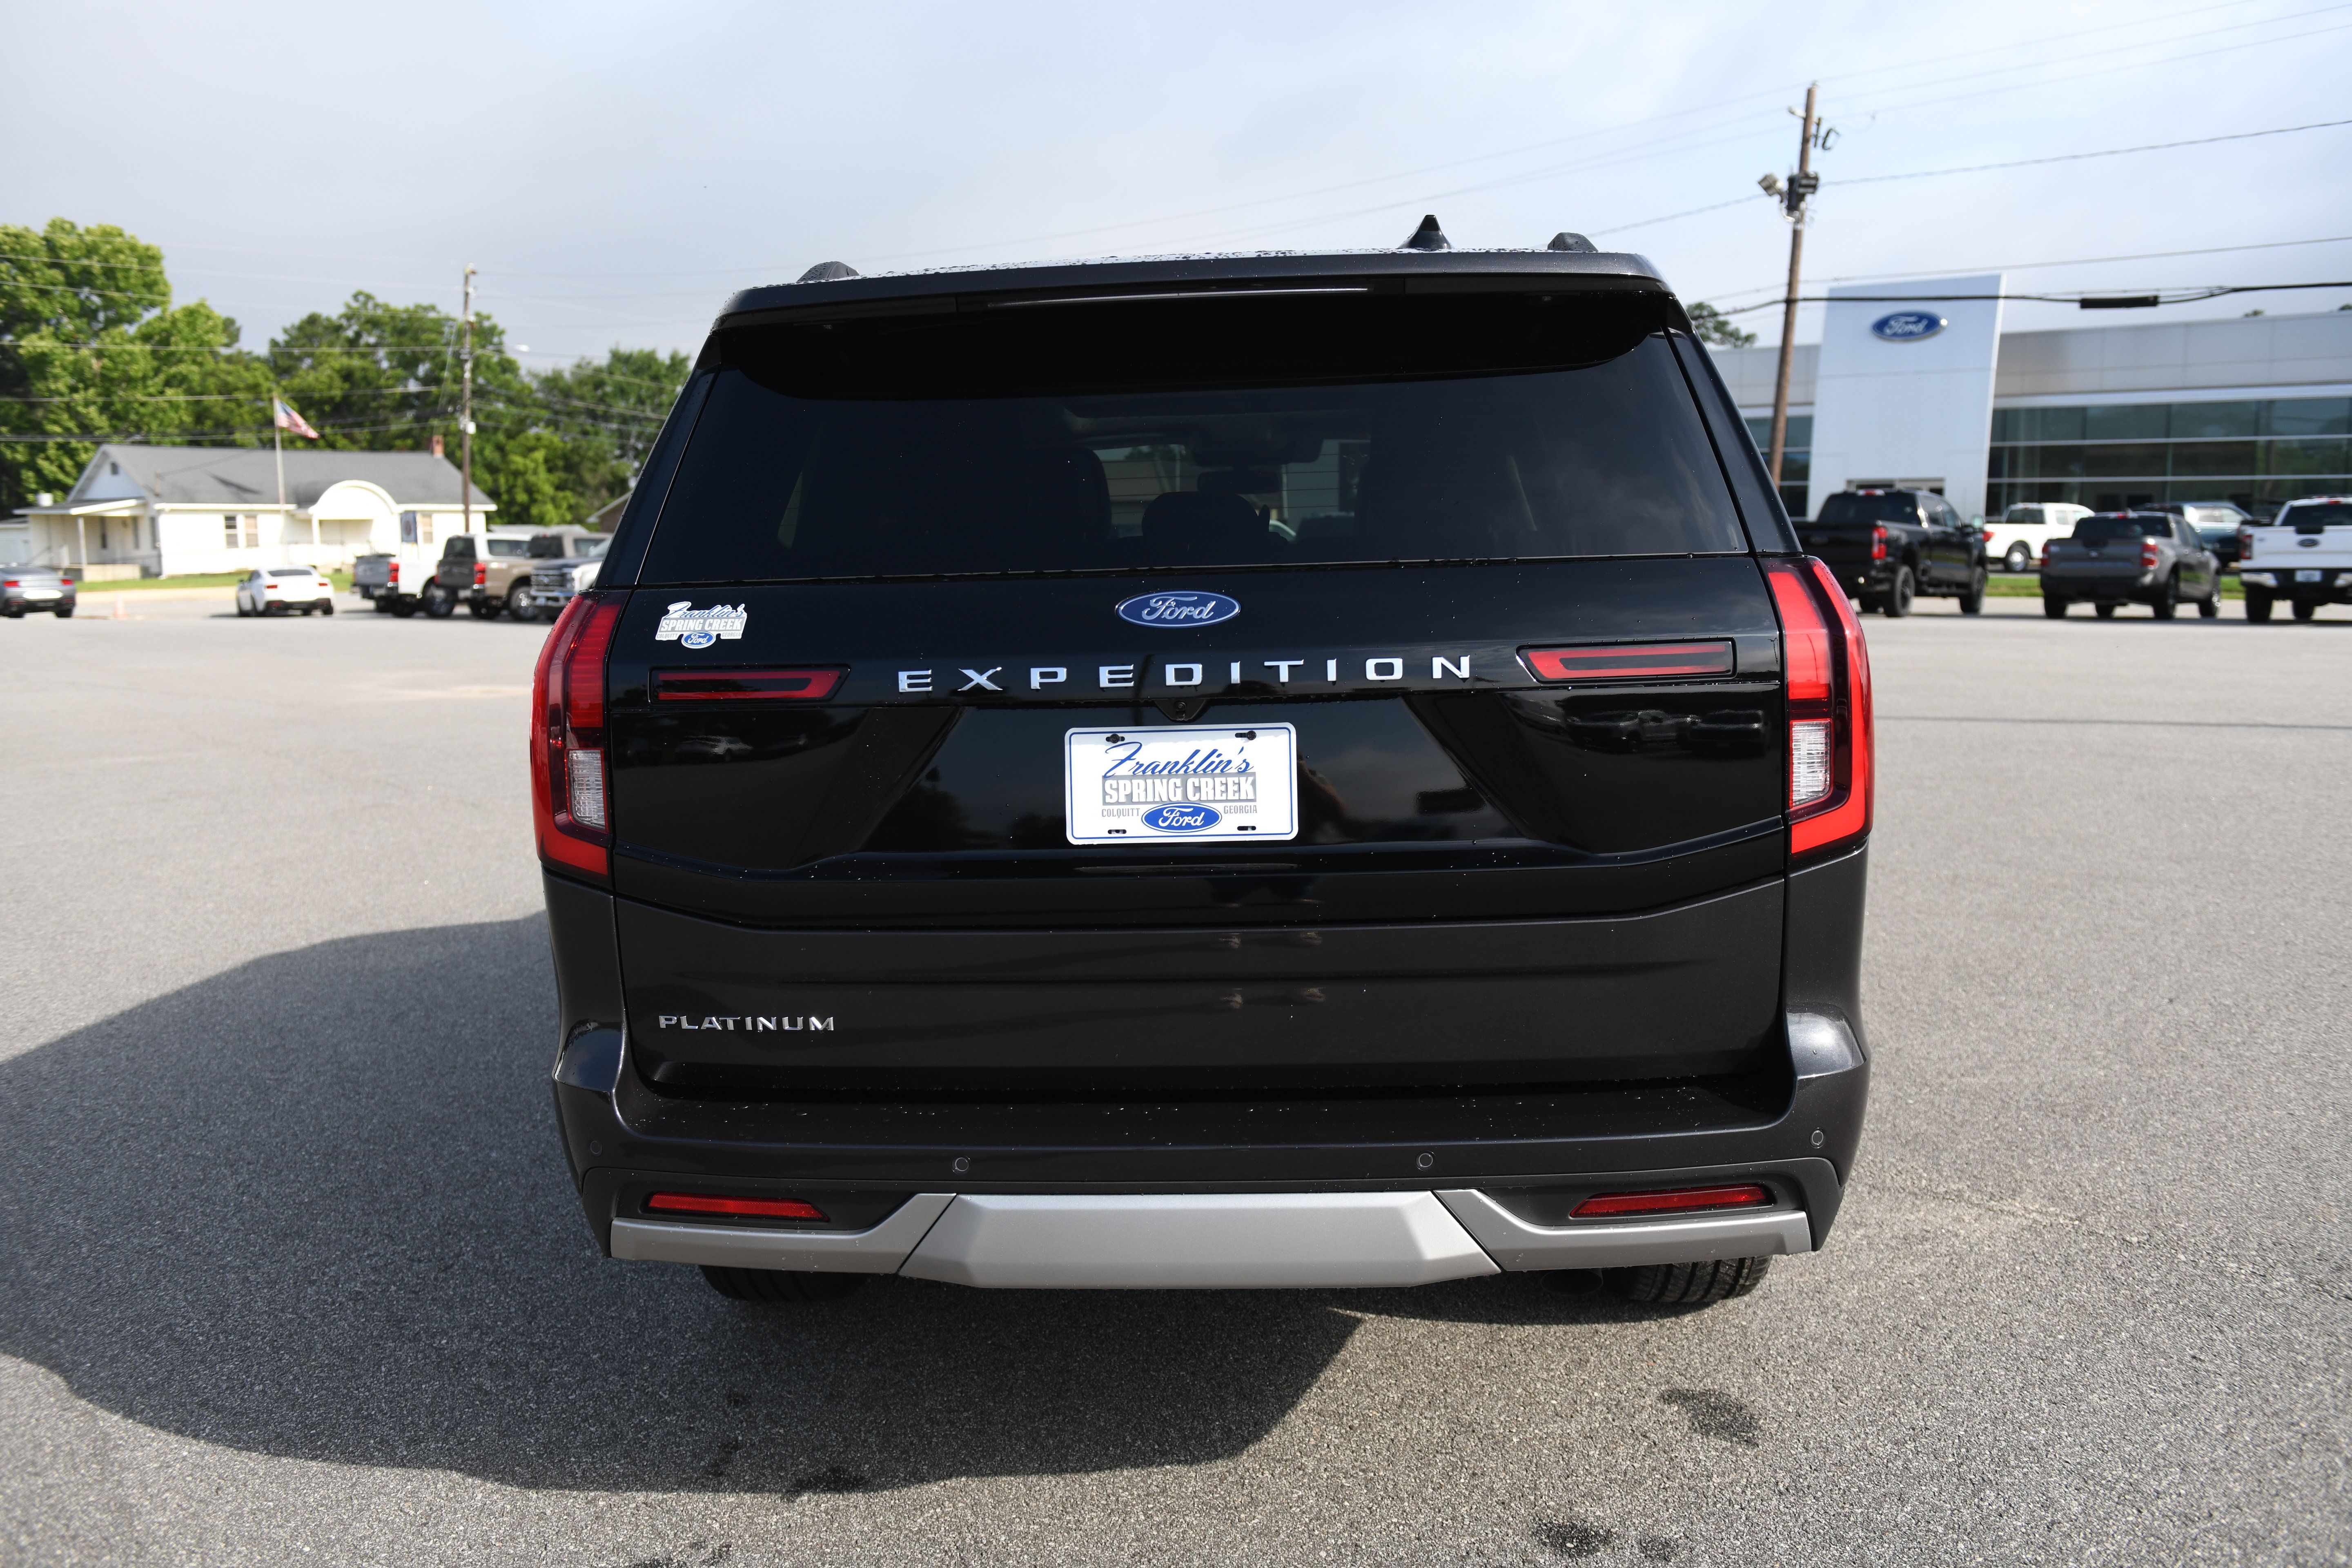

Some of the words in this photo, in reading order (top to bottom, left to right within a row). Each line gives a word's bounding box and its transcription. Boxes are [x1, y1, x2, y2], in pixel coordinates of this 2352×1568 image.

[1884, 316, 1928, 335] Ford
[664, 602, 744, 619] Franklin's
[1142, 596, 1216, 620] Ford
[661, 619, 703, 632] SPRING
[704, 618, 743, 631] CREEK
[688, 633, 708, 644] Ford
[898, 655, 1470, 693] EXPEDITION
[1103, 742, 1255, 779] Franklin's
[1105, 778, 1183, 804] SPRING
[1186, 776, 1255, 802] CREEK
[1102, 807, 1140, 818] COLQUITT
[1158, 807, 1205, 827] Ford
[1223, 805, 1258, 815] GEORGIA
[659, 1015, 834, 1031] PLATINUM
